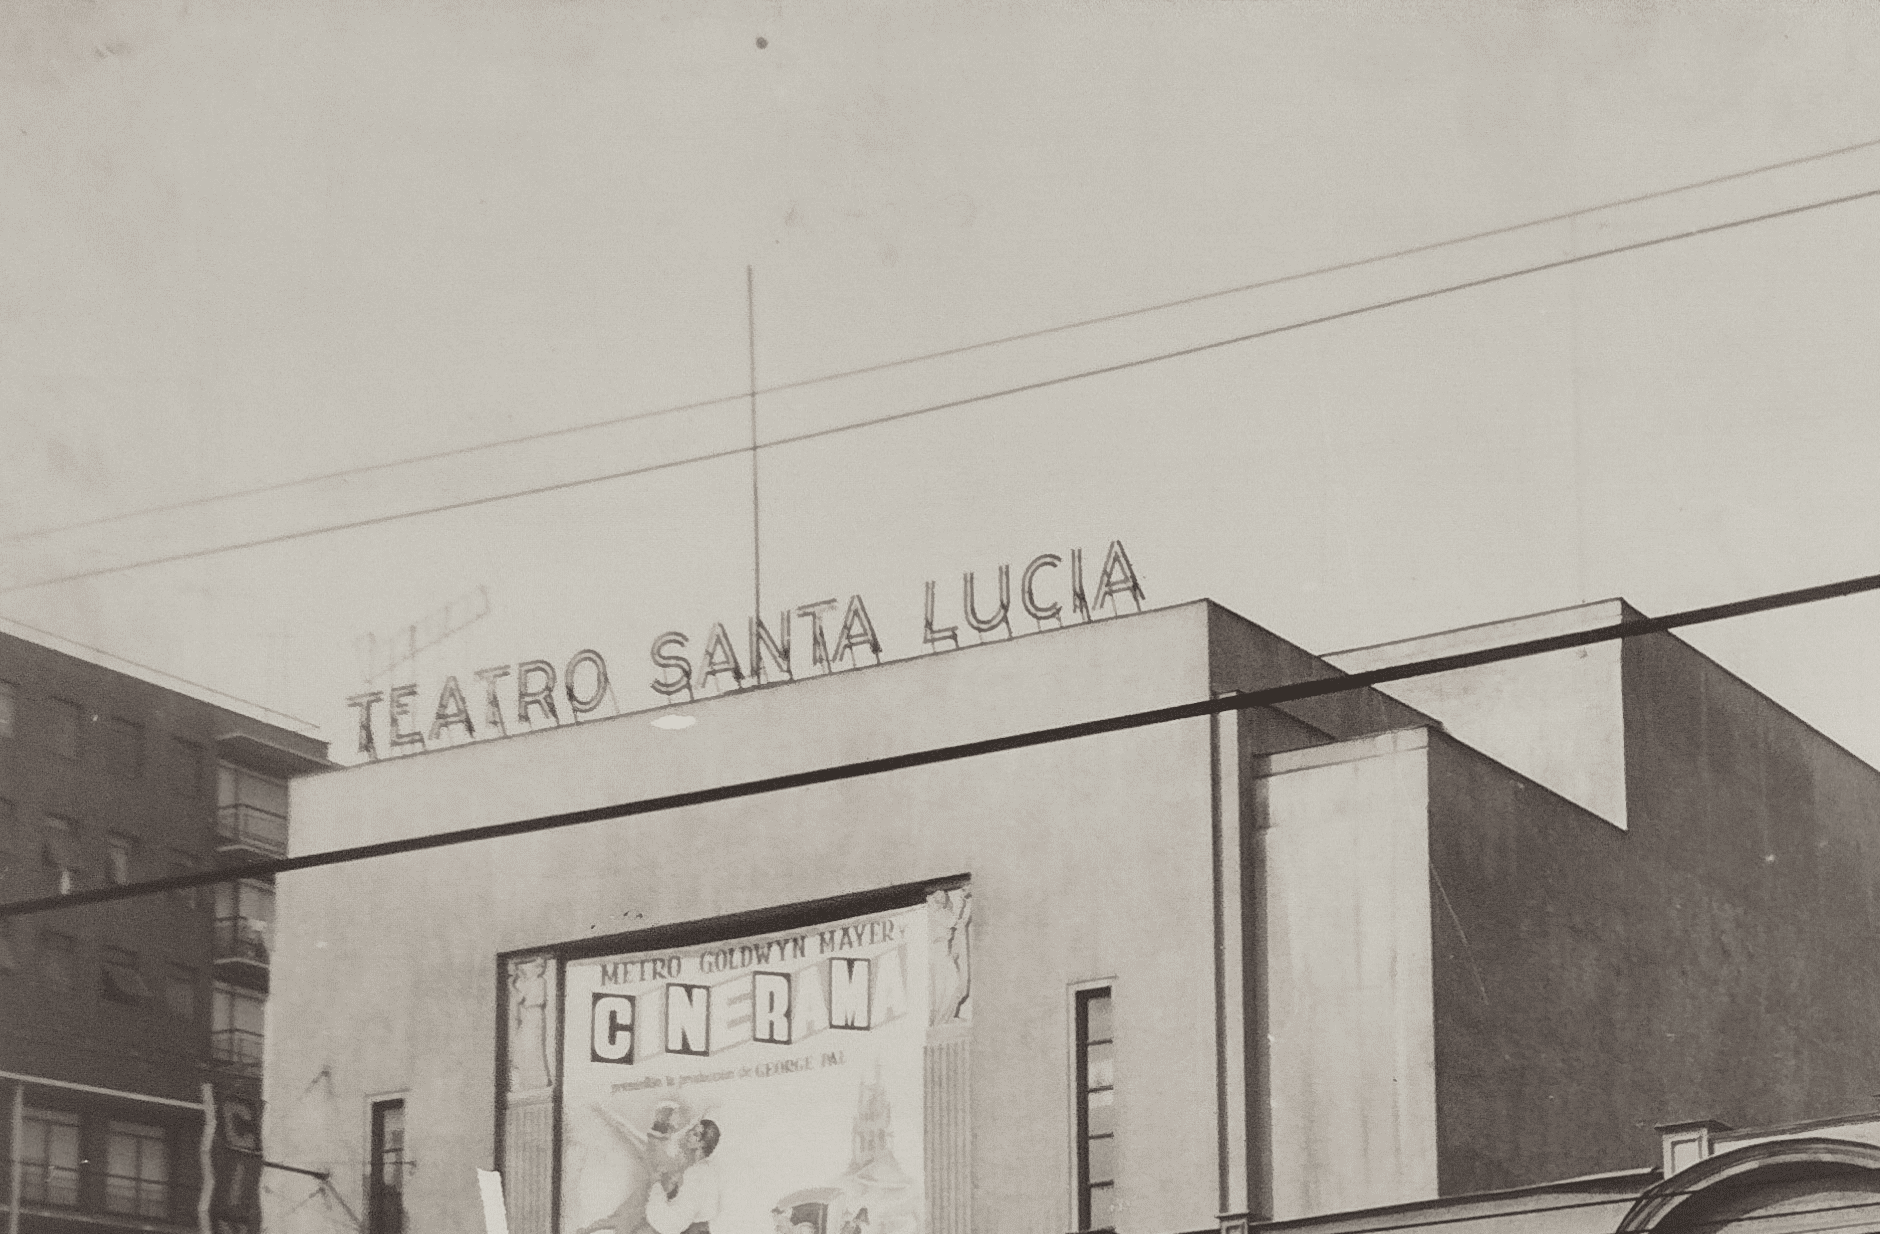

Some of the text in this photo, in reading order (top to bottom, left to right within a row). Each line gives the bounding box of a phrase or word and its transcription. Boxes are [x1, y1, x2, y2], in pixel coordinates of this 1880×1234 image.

[346, 540, 1146, 756] TEATRO SANTA LUCIA
[601, 956, 681, 986] METRO
[700, 936, 806, 976] GOLDWYN
[819, 919, 895, 955] MAYER
